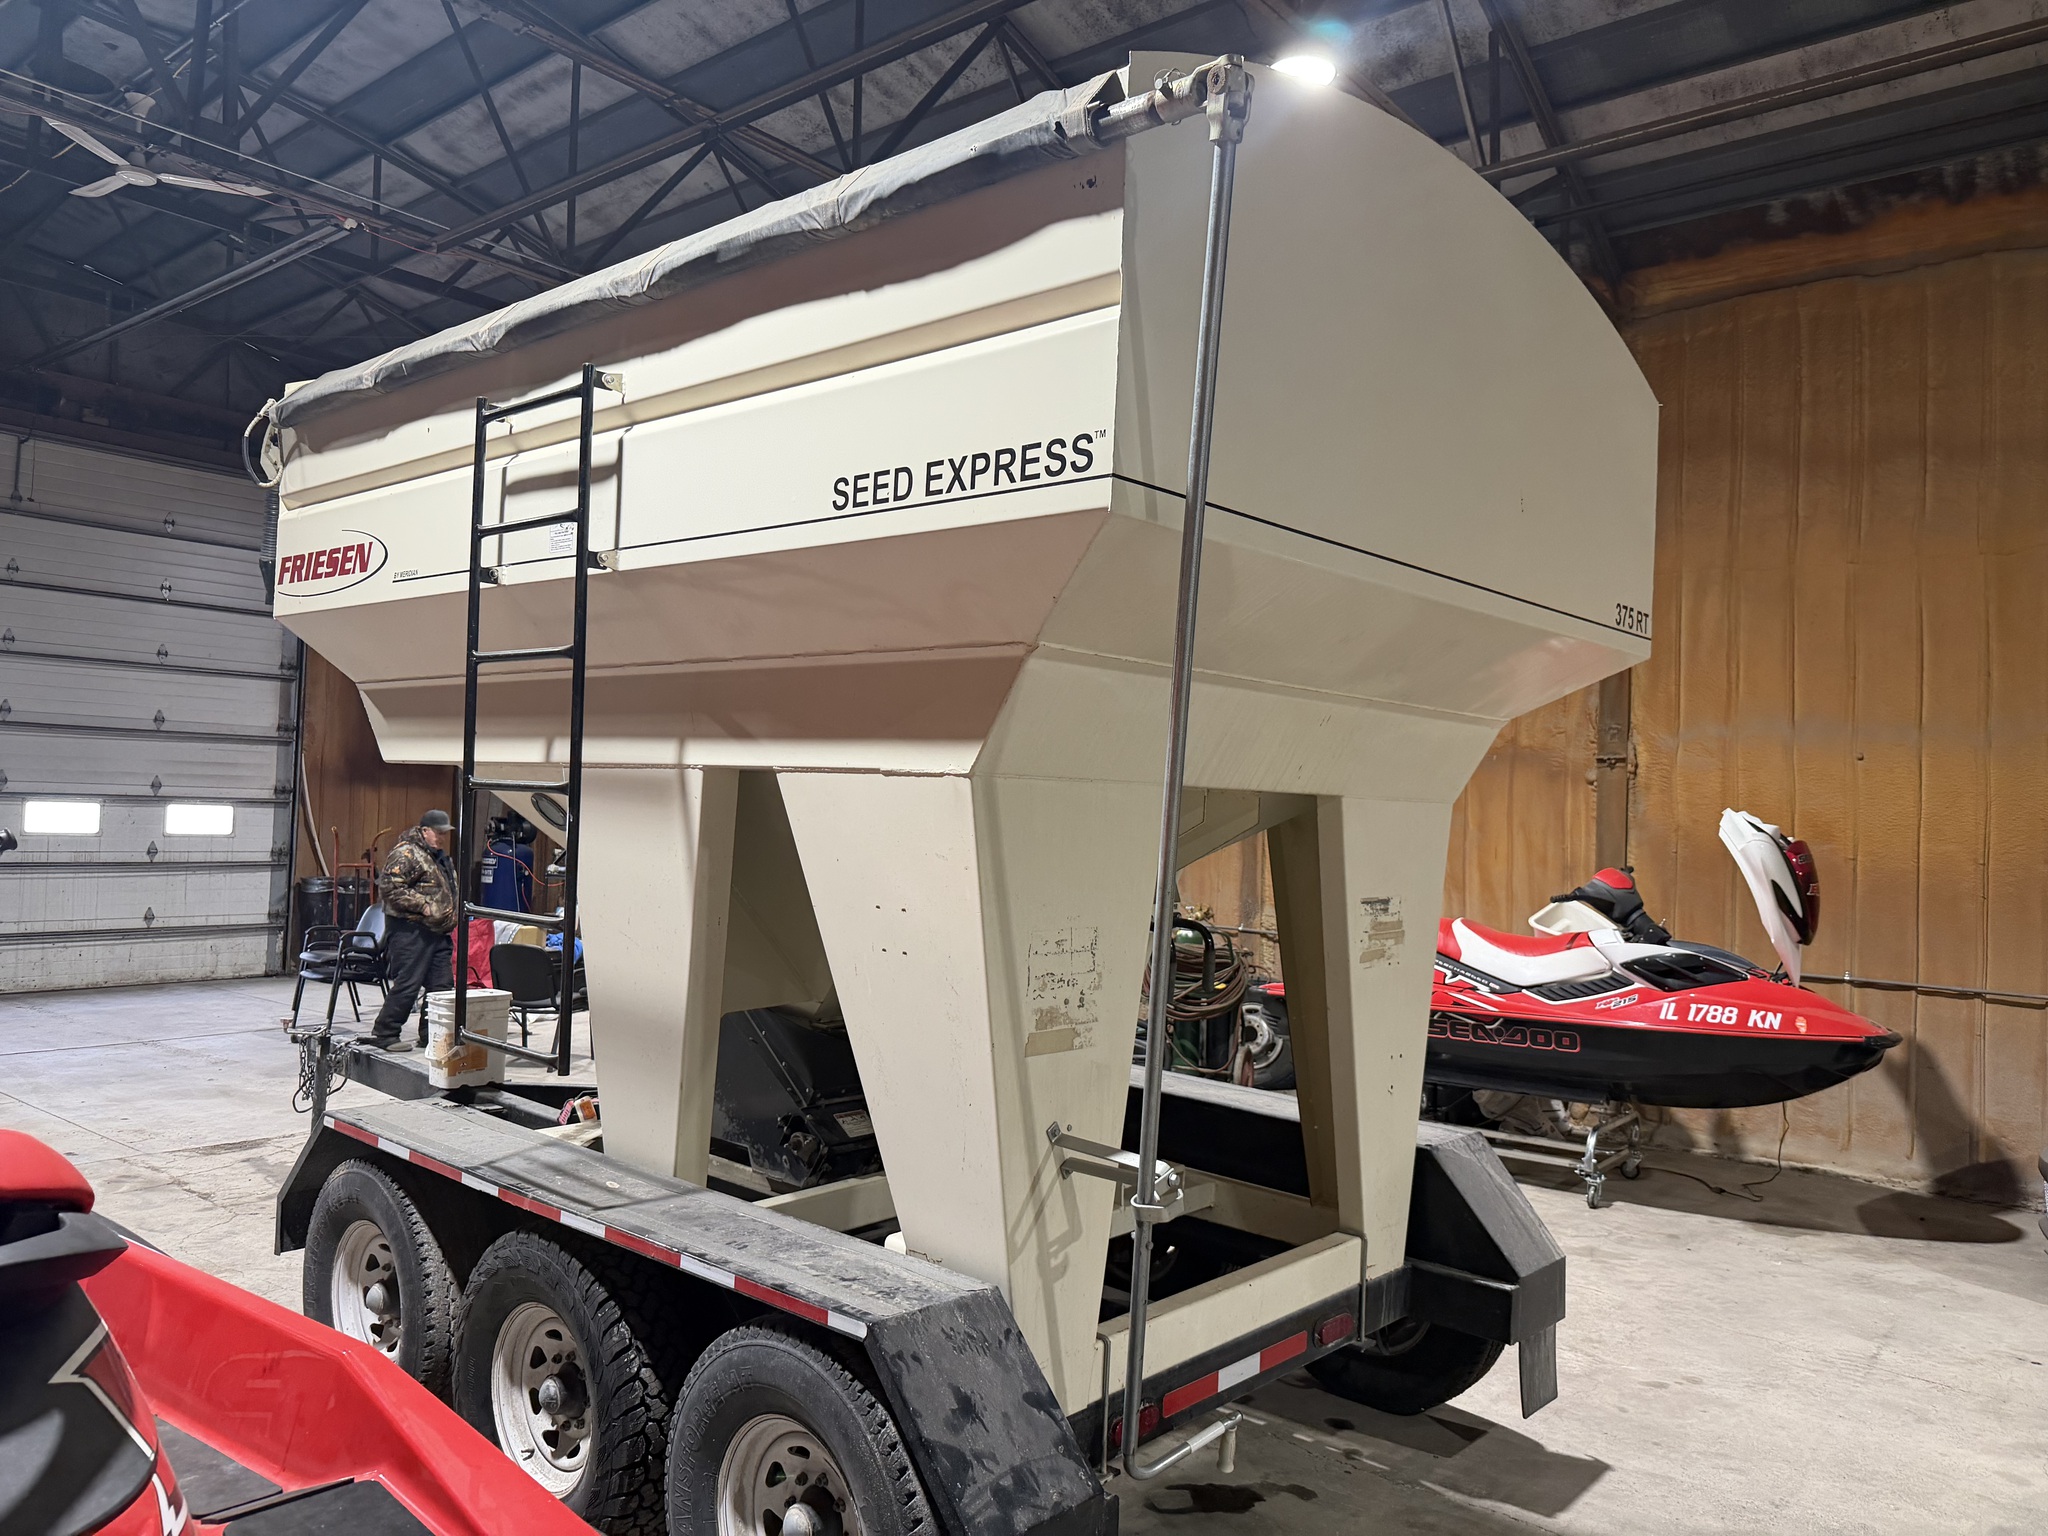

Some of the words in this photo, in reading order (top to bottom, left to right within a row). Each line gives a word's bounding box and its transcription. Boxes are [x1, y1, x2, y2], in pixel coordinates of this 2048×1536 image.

[832, 466, 913, 511] SEED
[925, 433, 1094, 497] EXPRESS
[277, 541, 373, 585] FRIESEN
[1615, 603, 1634, 630] 375
[1636, 610, 1649, 634] RT
[1659, 1003, 1679, 1020] IL
[1687, 1003, 1738, 1025] 1788
[1747, 1009, 1782, 1030] KN
